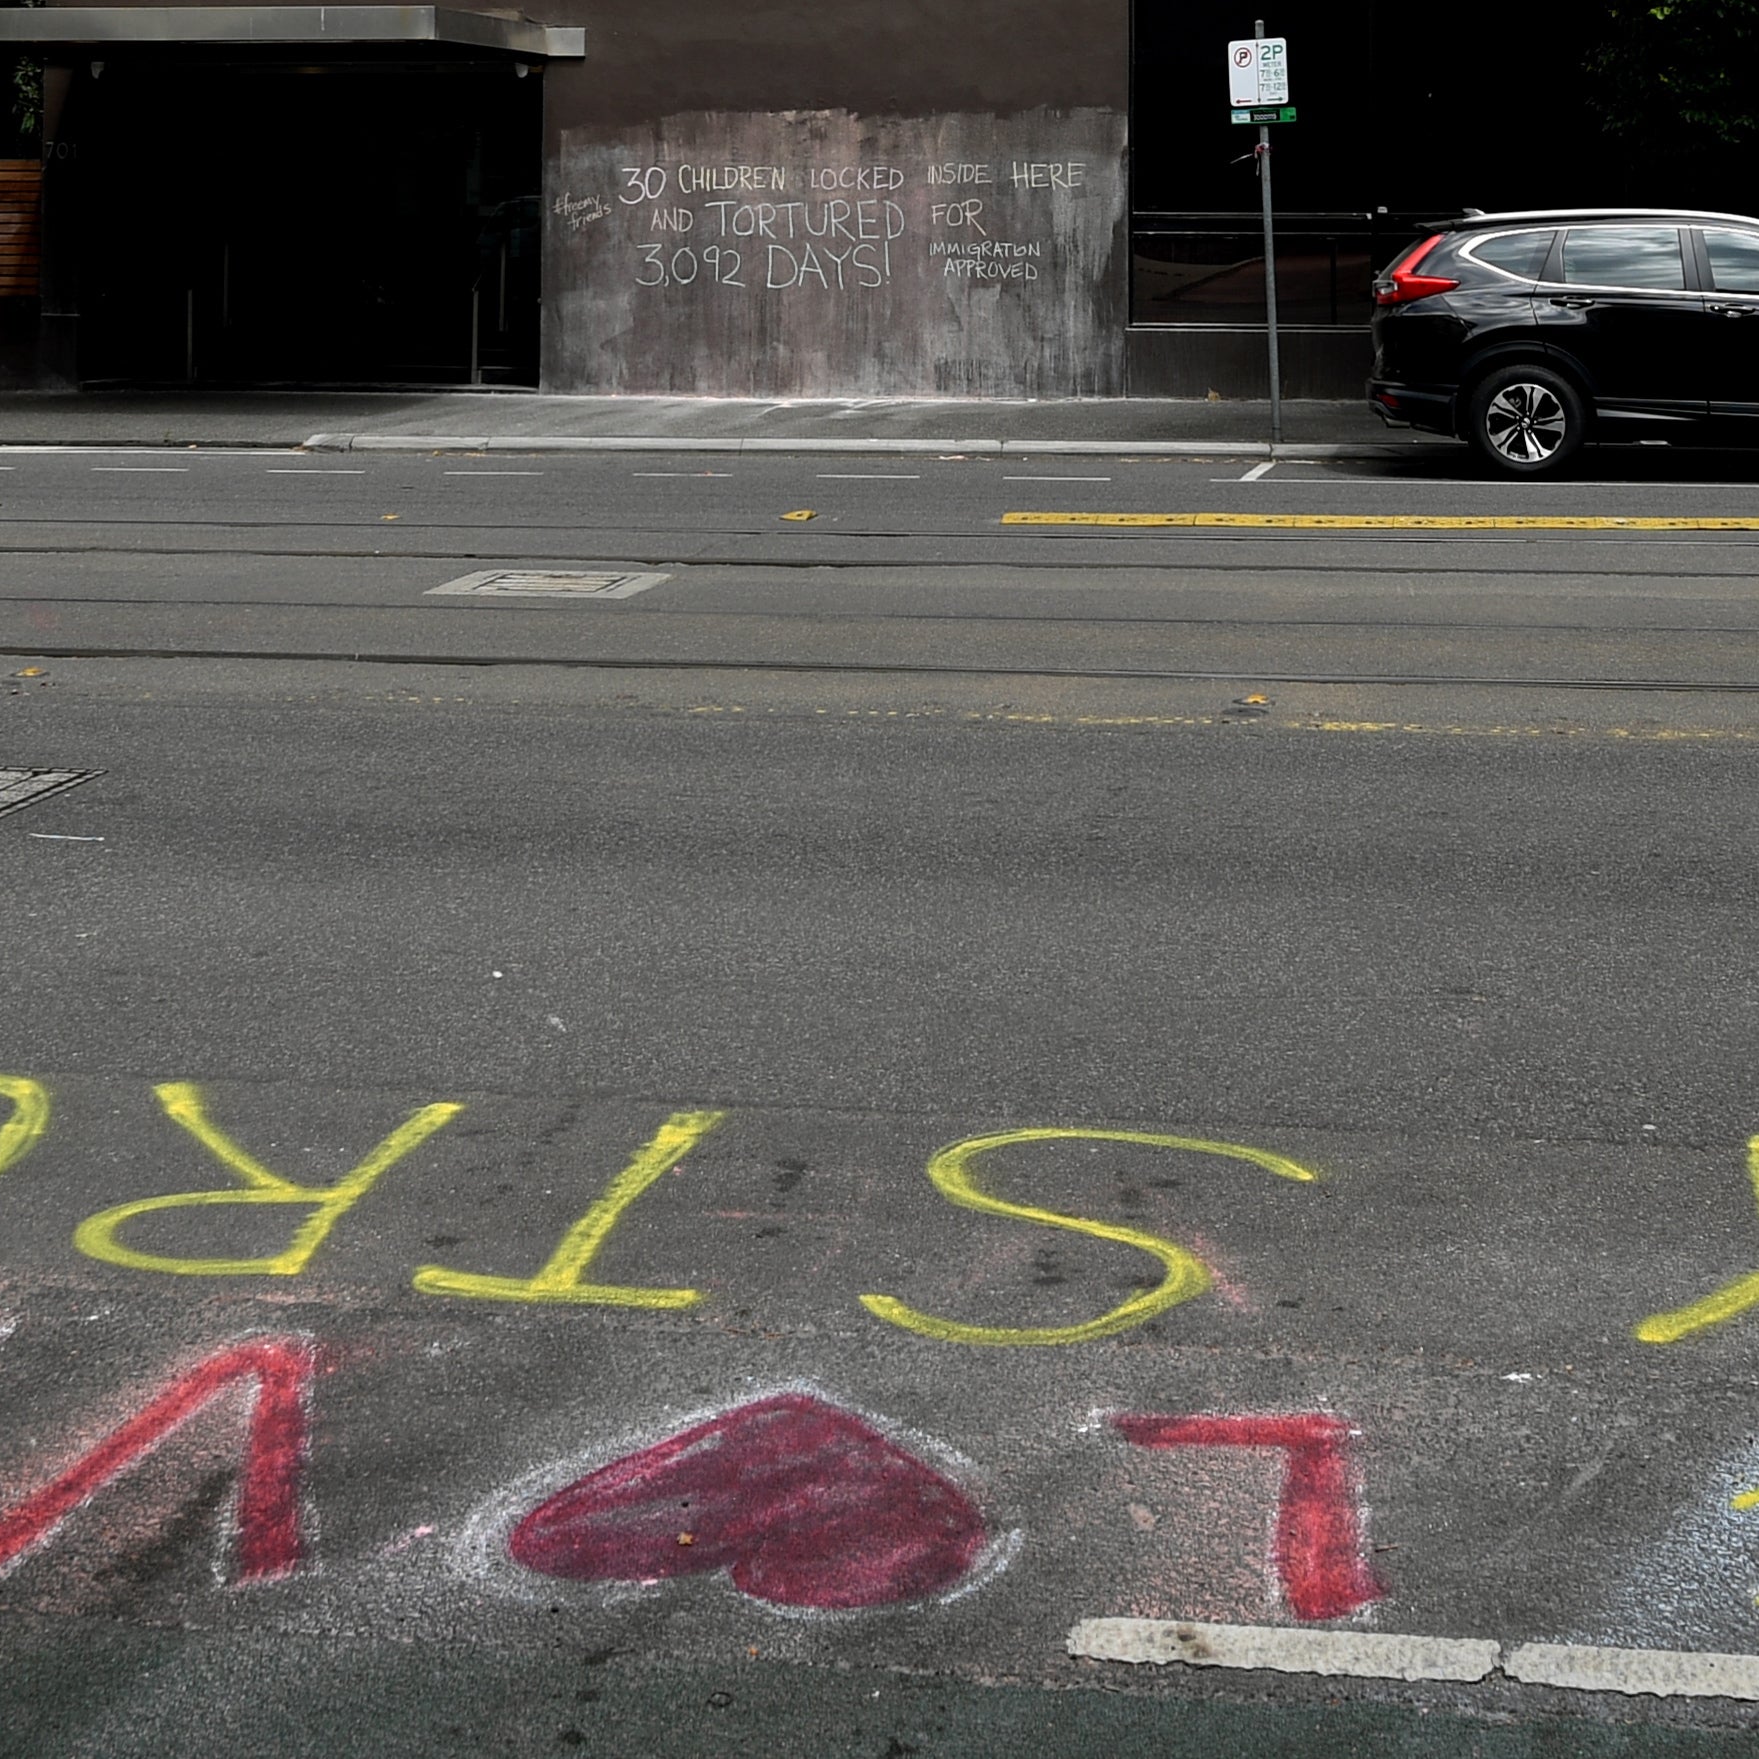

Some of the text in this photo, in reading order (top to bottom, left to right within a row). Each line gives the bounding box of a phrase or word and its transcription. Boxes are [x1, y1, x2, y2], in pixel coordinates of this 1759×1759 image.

[1260, 44, 1283, 60] 2P
[619, 161, 1087, 204] 30 CHILDREN LOCKED INSIDE HERE
[651, 199, 986, 241] AND TORTURED FOR
[636, 241, 890, 289] 3,092 DAYS!
[930, 241, 1040, 260] IMMIGRATION
[944, 258, 1037, 279] APPROVED
